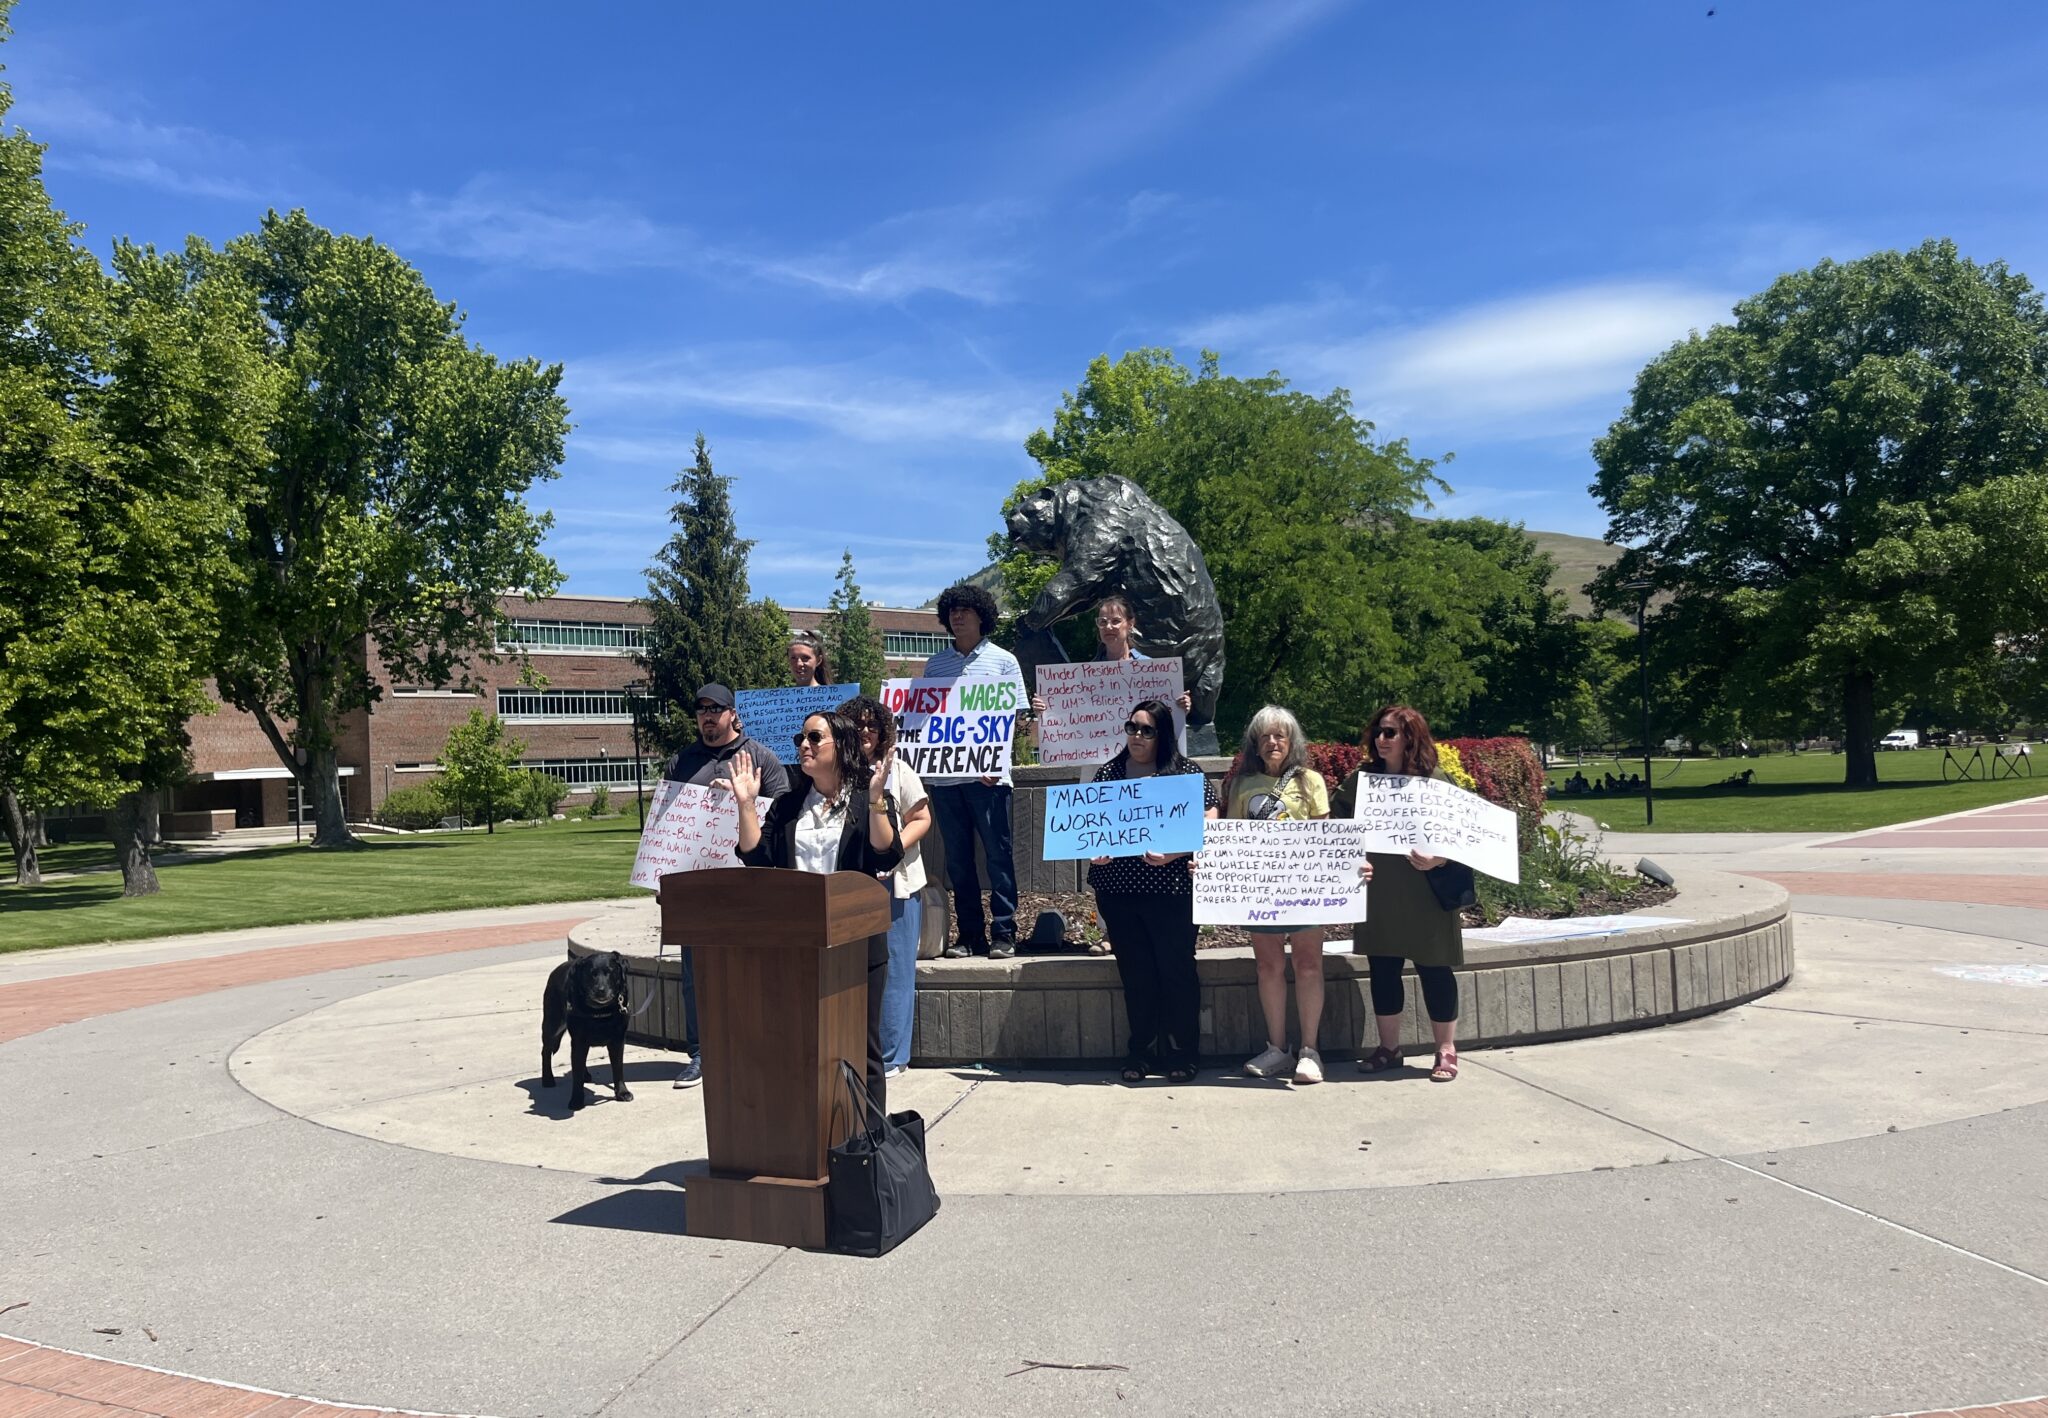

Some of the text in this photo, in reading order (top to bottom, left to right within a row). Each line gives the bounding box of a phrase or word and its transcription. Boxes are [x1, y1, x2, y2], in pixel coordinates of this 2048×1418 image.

[1082, 662, 1124, 678] President
[1039, 682, 1096, 697] Leadership
[1110, 680, 1120, 690] in
[1123, 677, 1172, 689] Violation
[883, 682, 1016, 714] LOWEST WAGES
[1091, 695, 1125, 706] Policies
[894, 716, 905, 728] N
[897, 714, 1015, 744] THE BIG-SKY
[1042, 730, 1084, 743] Actions
[894, 745, 1003, 774] NFERENCE
[1043, 748, 1099, 763] Contradicted
[1118, 783, 1143, 800] ME
[1417, 778, 1441, 791] THE
[1448, 784, 1490, 811] LOWEST
[1367, 793, 1478, 820] IN THE BIG SKY
[706, 817, 720, 830] of
[1050, 801, 1190, 833] WORK WITH MY
[1250, 821, 1318, 833] PRESIDENT
[1364, 807, 1508, 843] CONFERENCE DESPITE
[1388, 833, 1417, 844] THE
[1423, 821, 1461, 837] COACH
[1467, 834, 1481, 844] OF
[1203, 835, 1257, 845] EADERSHIP
[1283, 837, 1300, 845] IN
[1304, 836, 1360, 846] VIOLATION
[1196, 850, 1211, 859] OF
[1237, 849, 1287, 859] POLICIES
[1290, 850, 1315, 859] AND
[1319, 848, 1366, 859] FEDERAL
[1196, 861, 1216, 870] LAW
[1220, 861, 1259, 870] WHILE
[1263, 861, 1285, 870] MEN
[1304, 862, 1322, 871] UM
[1327, 861, 1351, 871] HAD
[1195, 871, 1213, 880] THE
[1216, 872, 1292, 883] OPPORTUNITY
[1298, 875, 1309, 883] TO
[1276, 887, 1297, 895] AND
[1301, 887, 1325, 895] HAVE
[1331, 886, 1360, 895] LONG
[1196, 896, 1237, 904] CAREERS
[1274, 898, 1320, 907] WOMEN
[1323, 898, 1348, 907] DID
